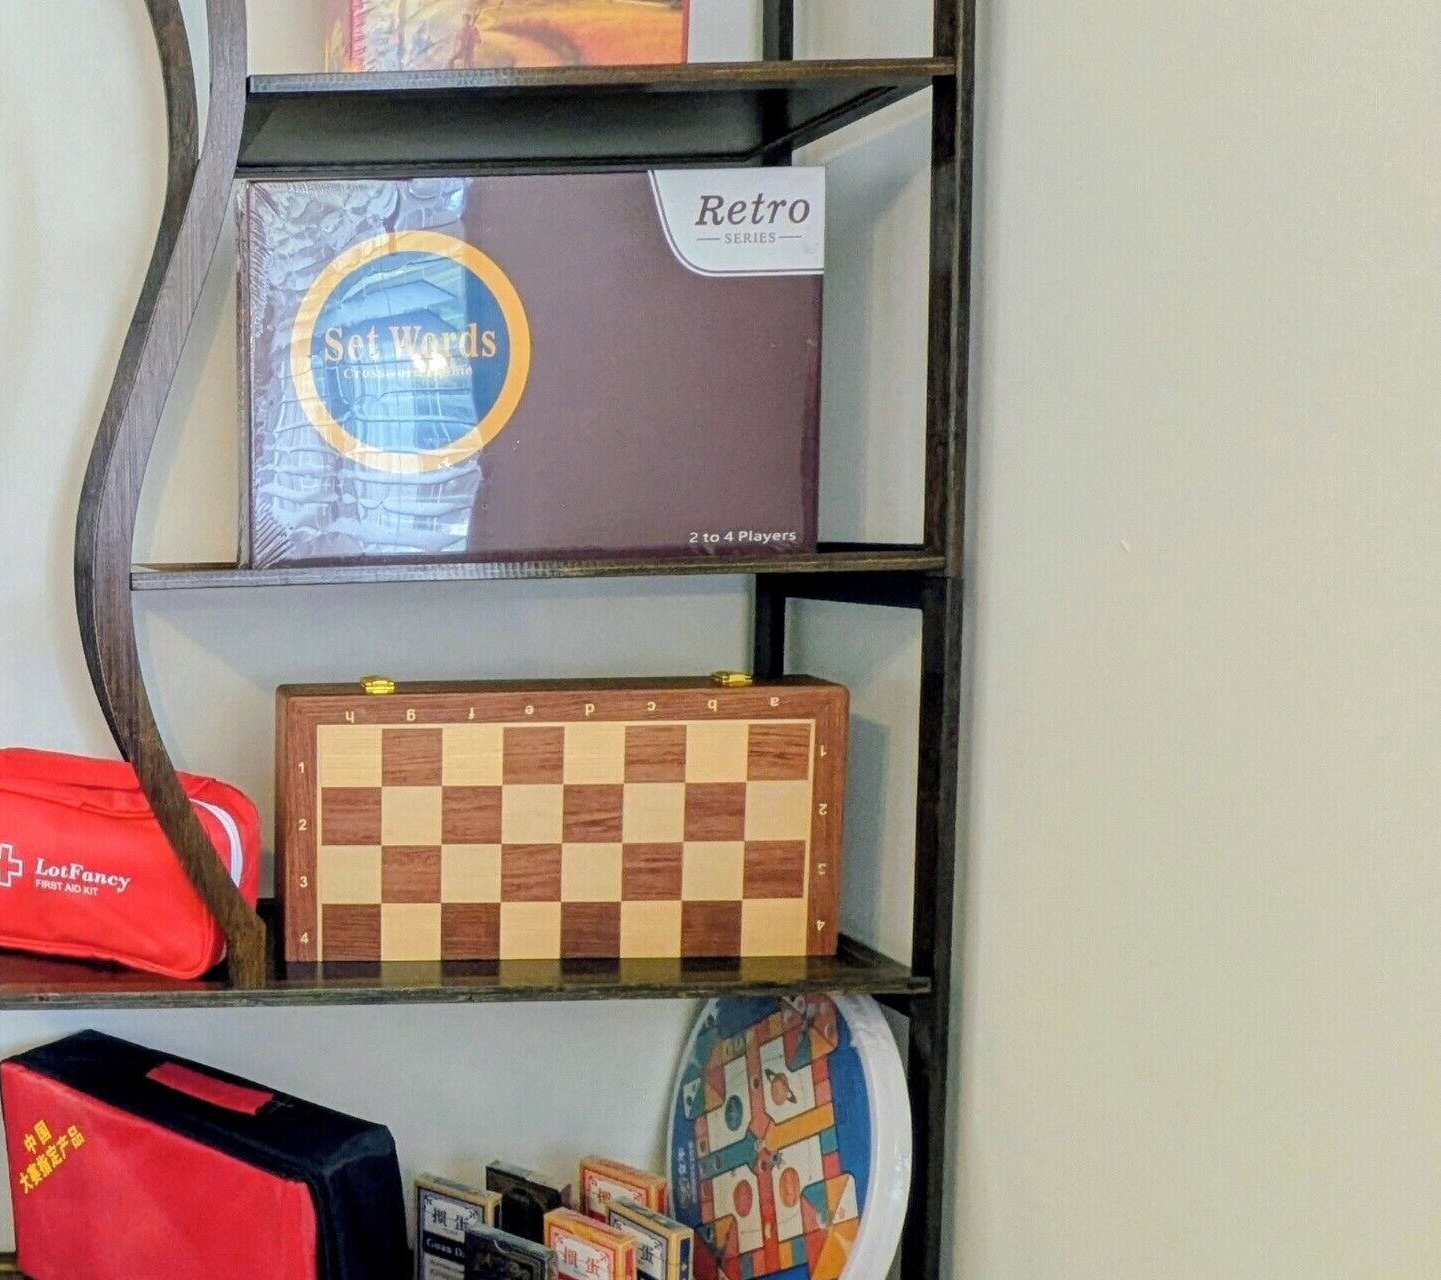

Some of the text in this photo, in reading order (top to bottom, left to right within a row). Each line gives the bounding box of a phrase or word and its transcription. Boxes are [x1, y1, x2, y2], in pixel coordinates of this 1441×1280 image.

[694, 192, 811, 226] Retro
[724, 232, 776, 245] SERIES
[324, 322, 497, 362] Set Words
[688, 530, 797, 545] 2 to 4 Players
[647, 701, 656, 712] c
[770, 697, 779, 707] a
[524, 705, 534, 715] e
[298, 761, 305, 774] 1
[298, 818, 307, 831] 2
[34, 857, 132, 894] LotFancy
[299, 876, 308, 888] 3
[35, 878, 99, 896] FIRST AID KIT
[299, 932, 309, 944] 4
[23, 1119, 52, 1155] 中国
[19, 1124, 86, 1195] 大赛指定产品
